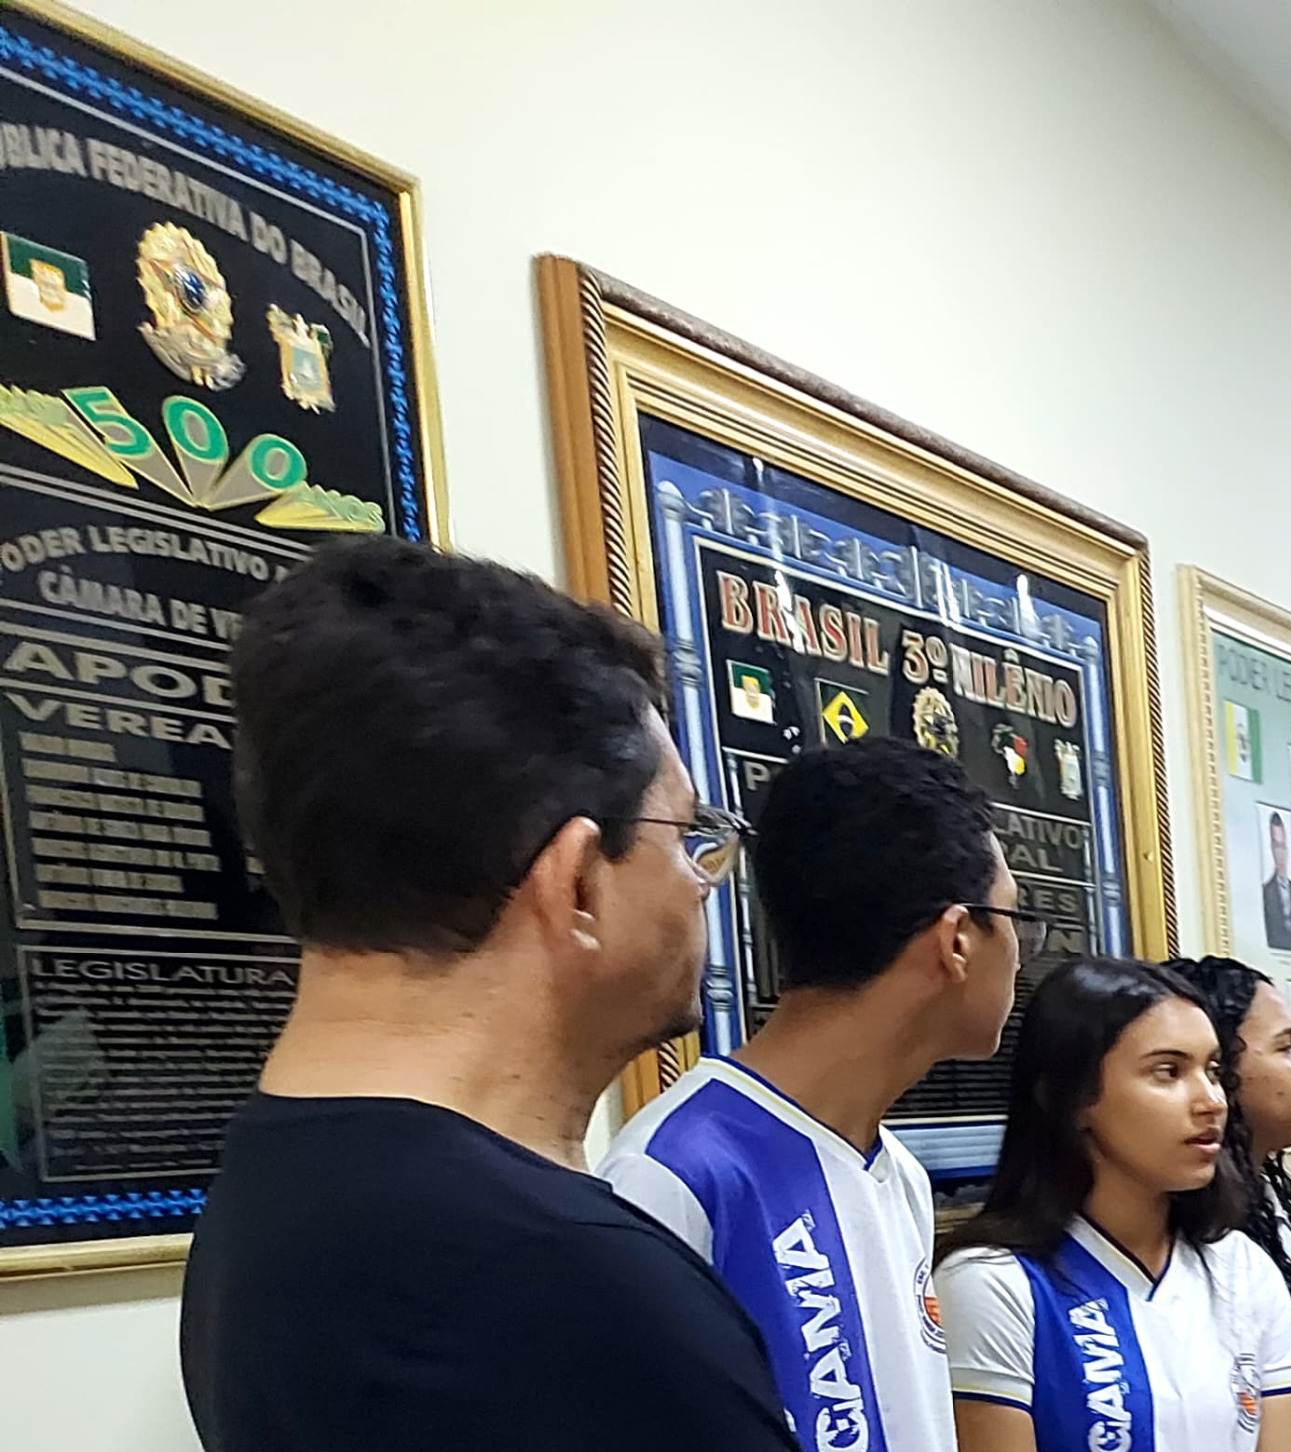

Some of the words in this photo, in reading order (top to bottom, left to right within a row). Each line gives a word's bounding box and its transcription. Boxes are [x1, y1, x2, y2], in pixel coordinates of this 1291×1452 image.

[87, 137, 248, 242] FEDERATIVA
[250, 210, 287, 265] DO
[87, 525, 269, 581] LEGISLATIVO
[37, 565, 166, 627] CÂMARA
[170, 598, 207, 636] DE
[716, 570, 890, 677] BRASIL
[30, 957, 296, 986] LEGISLATURA
